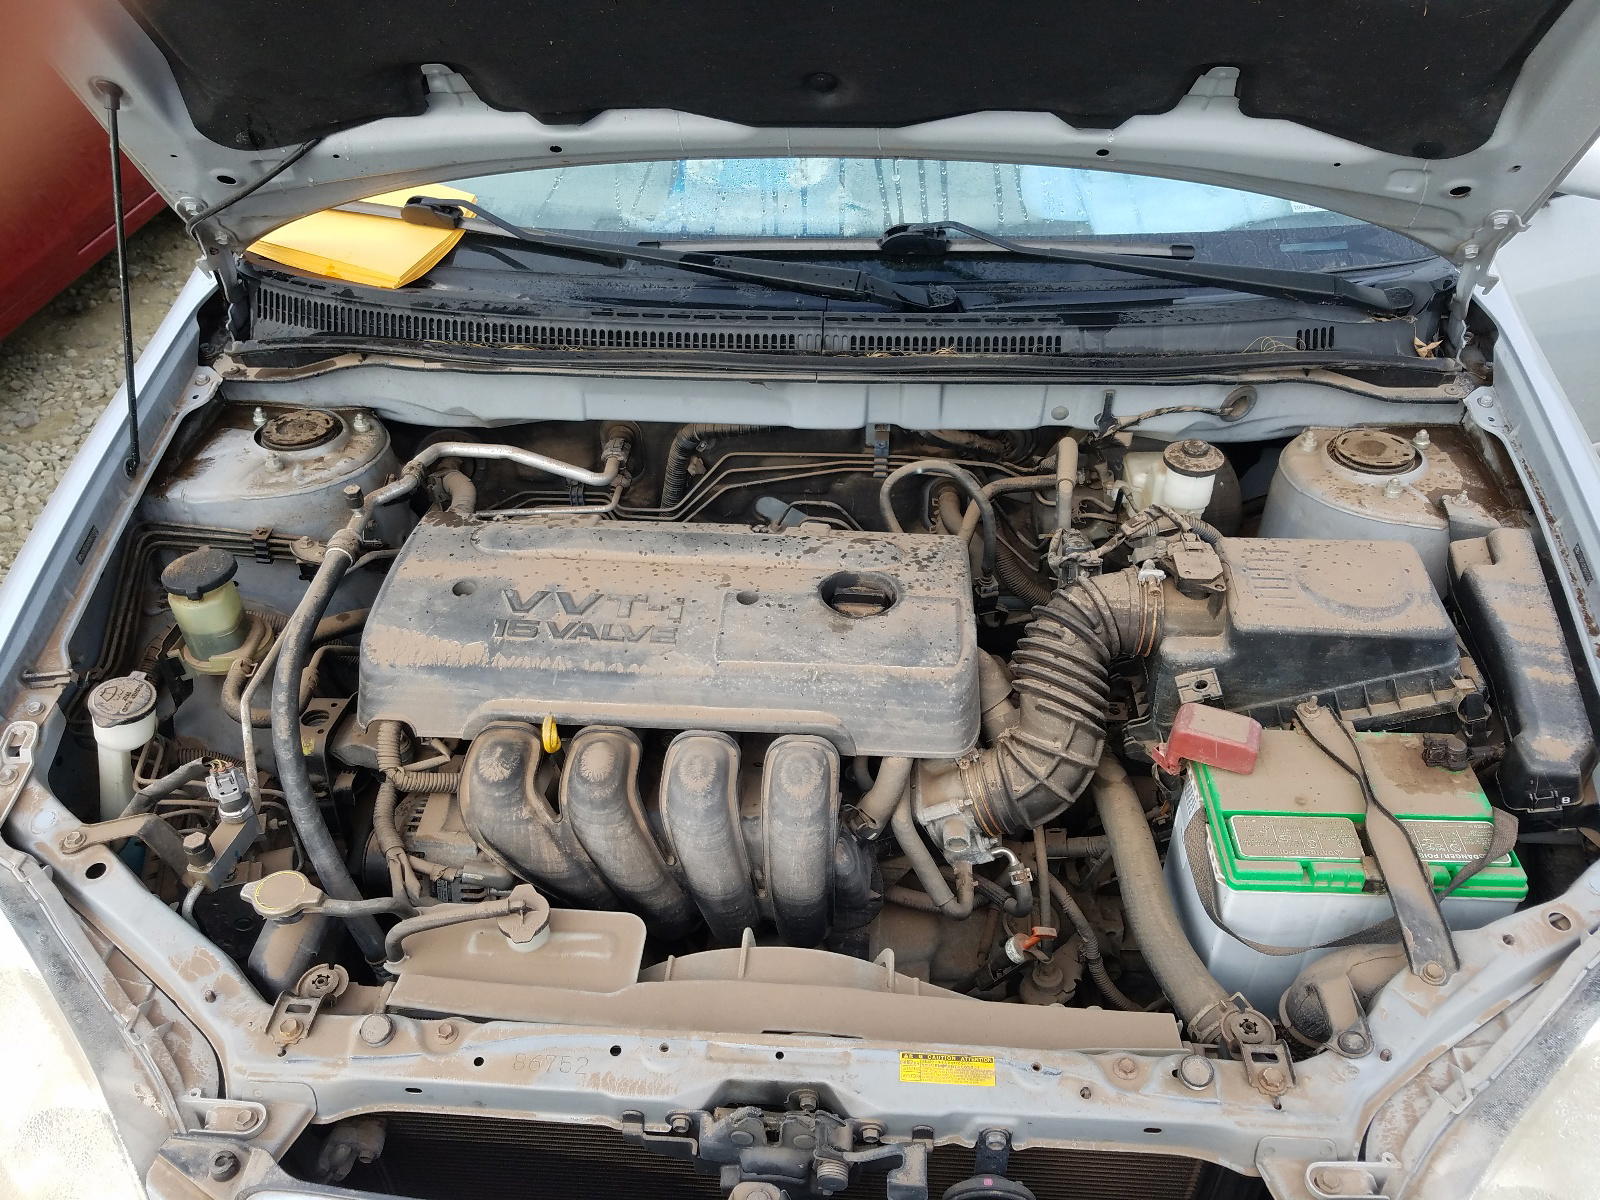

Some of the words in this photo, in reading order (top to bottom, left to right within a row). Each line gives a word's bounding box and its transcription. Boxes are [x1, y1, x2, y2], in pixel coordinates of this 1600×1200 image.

[493, 618, 541, 639] 16
[547, 621, 678, 645] VALVE
[512, 1053, 589, 1075] 86752
